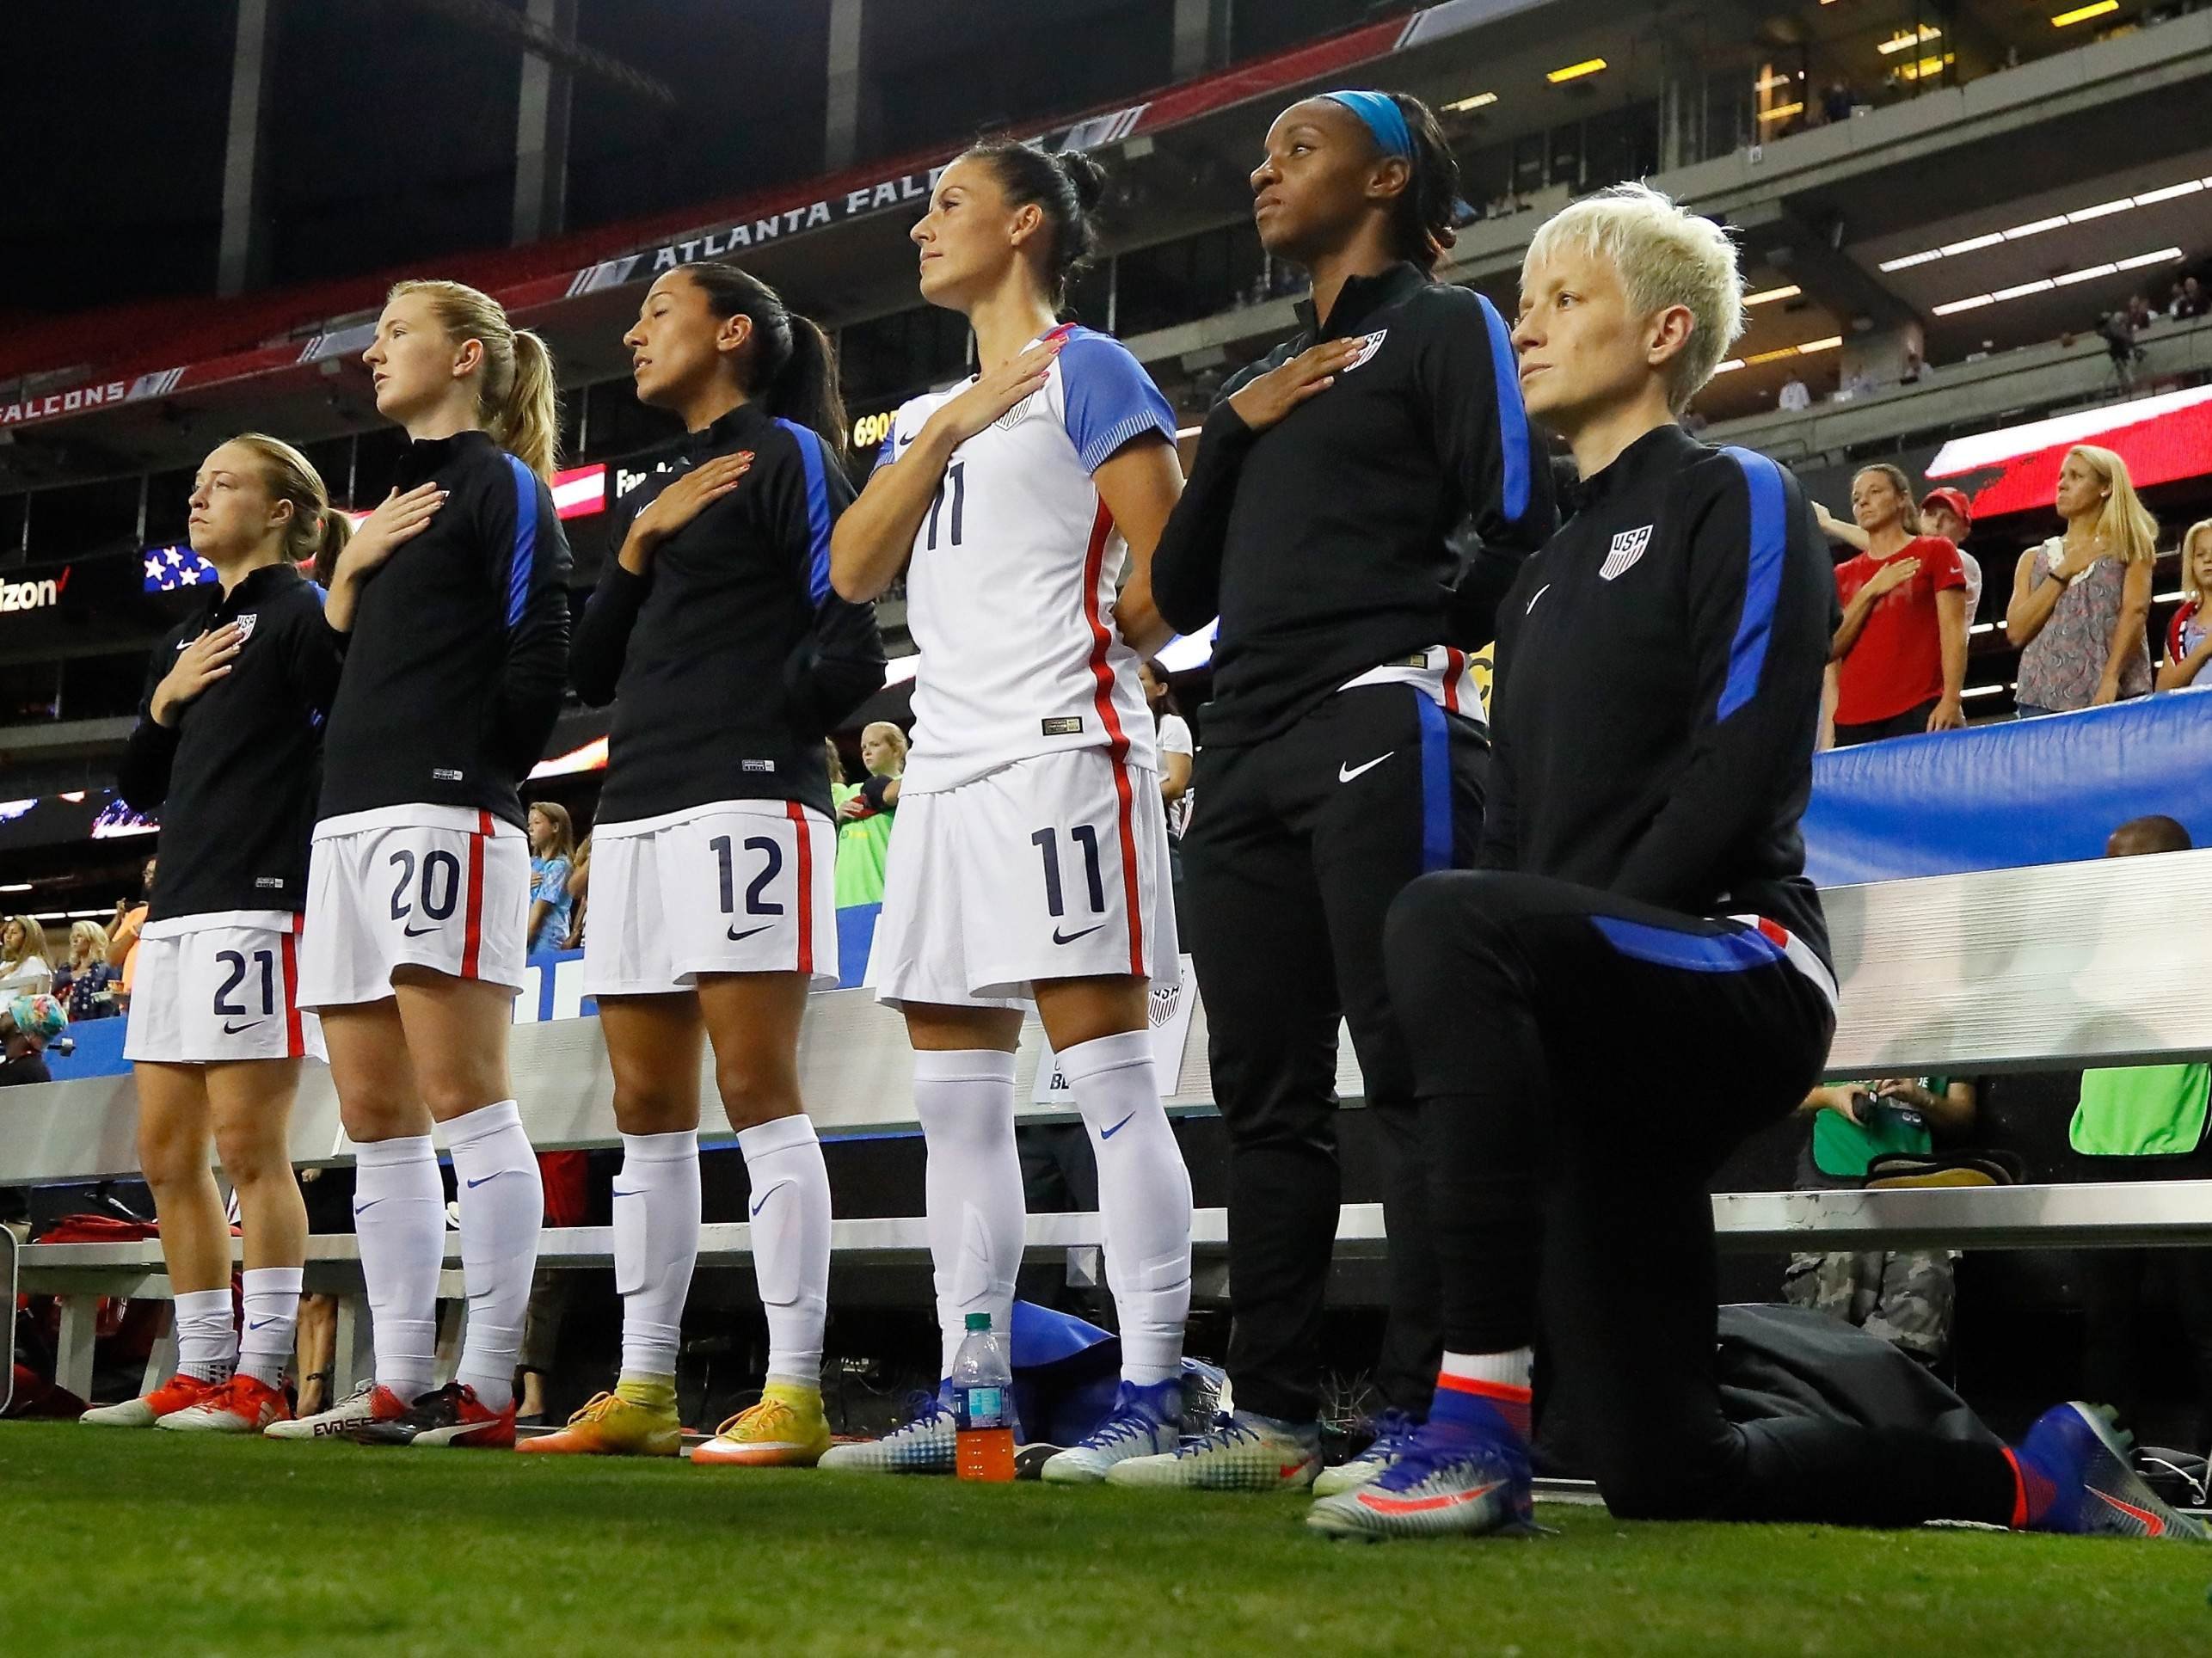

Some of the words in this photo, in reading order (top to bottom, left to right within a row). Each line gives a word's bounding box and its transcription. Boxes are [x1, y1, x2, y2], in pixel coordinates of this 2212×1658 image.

[654, 201, 832, 271] ATLANTA
[0, 381, 125, 423] ALCONS
[927, 461, 964, 550] 11
[1613, 528, 1650, 552] USA
[390, 849, 460, 921] 20
[710, 835, 783, 915] 12
[1031, 825, 1105, 917] 11
[214, 950, 273, 1016] 21
